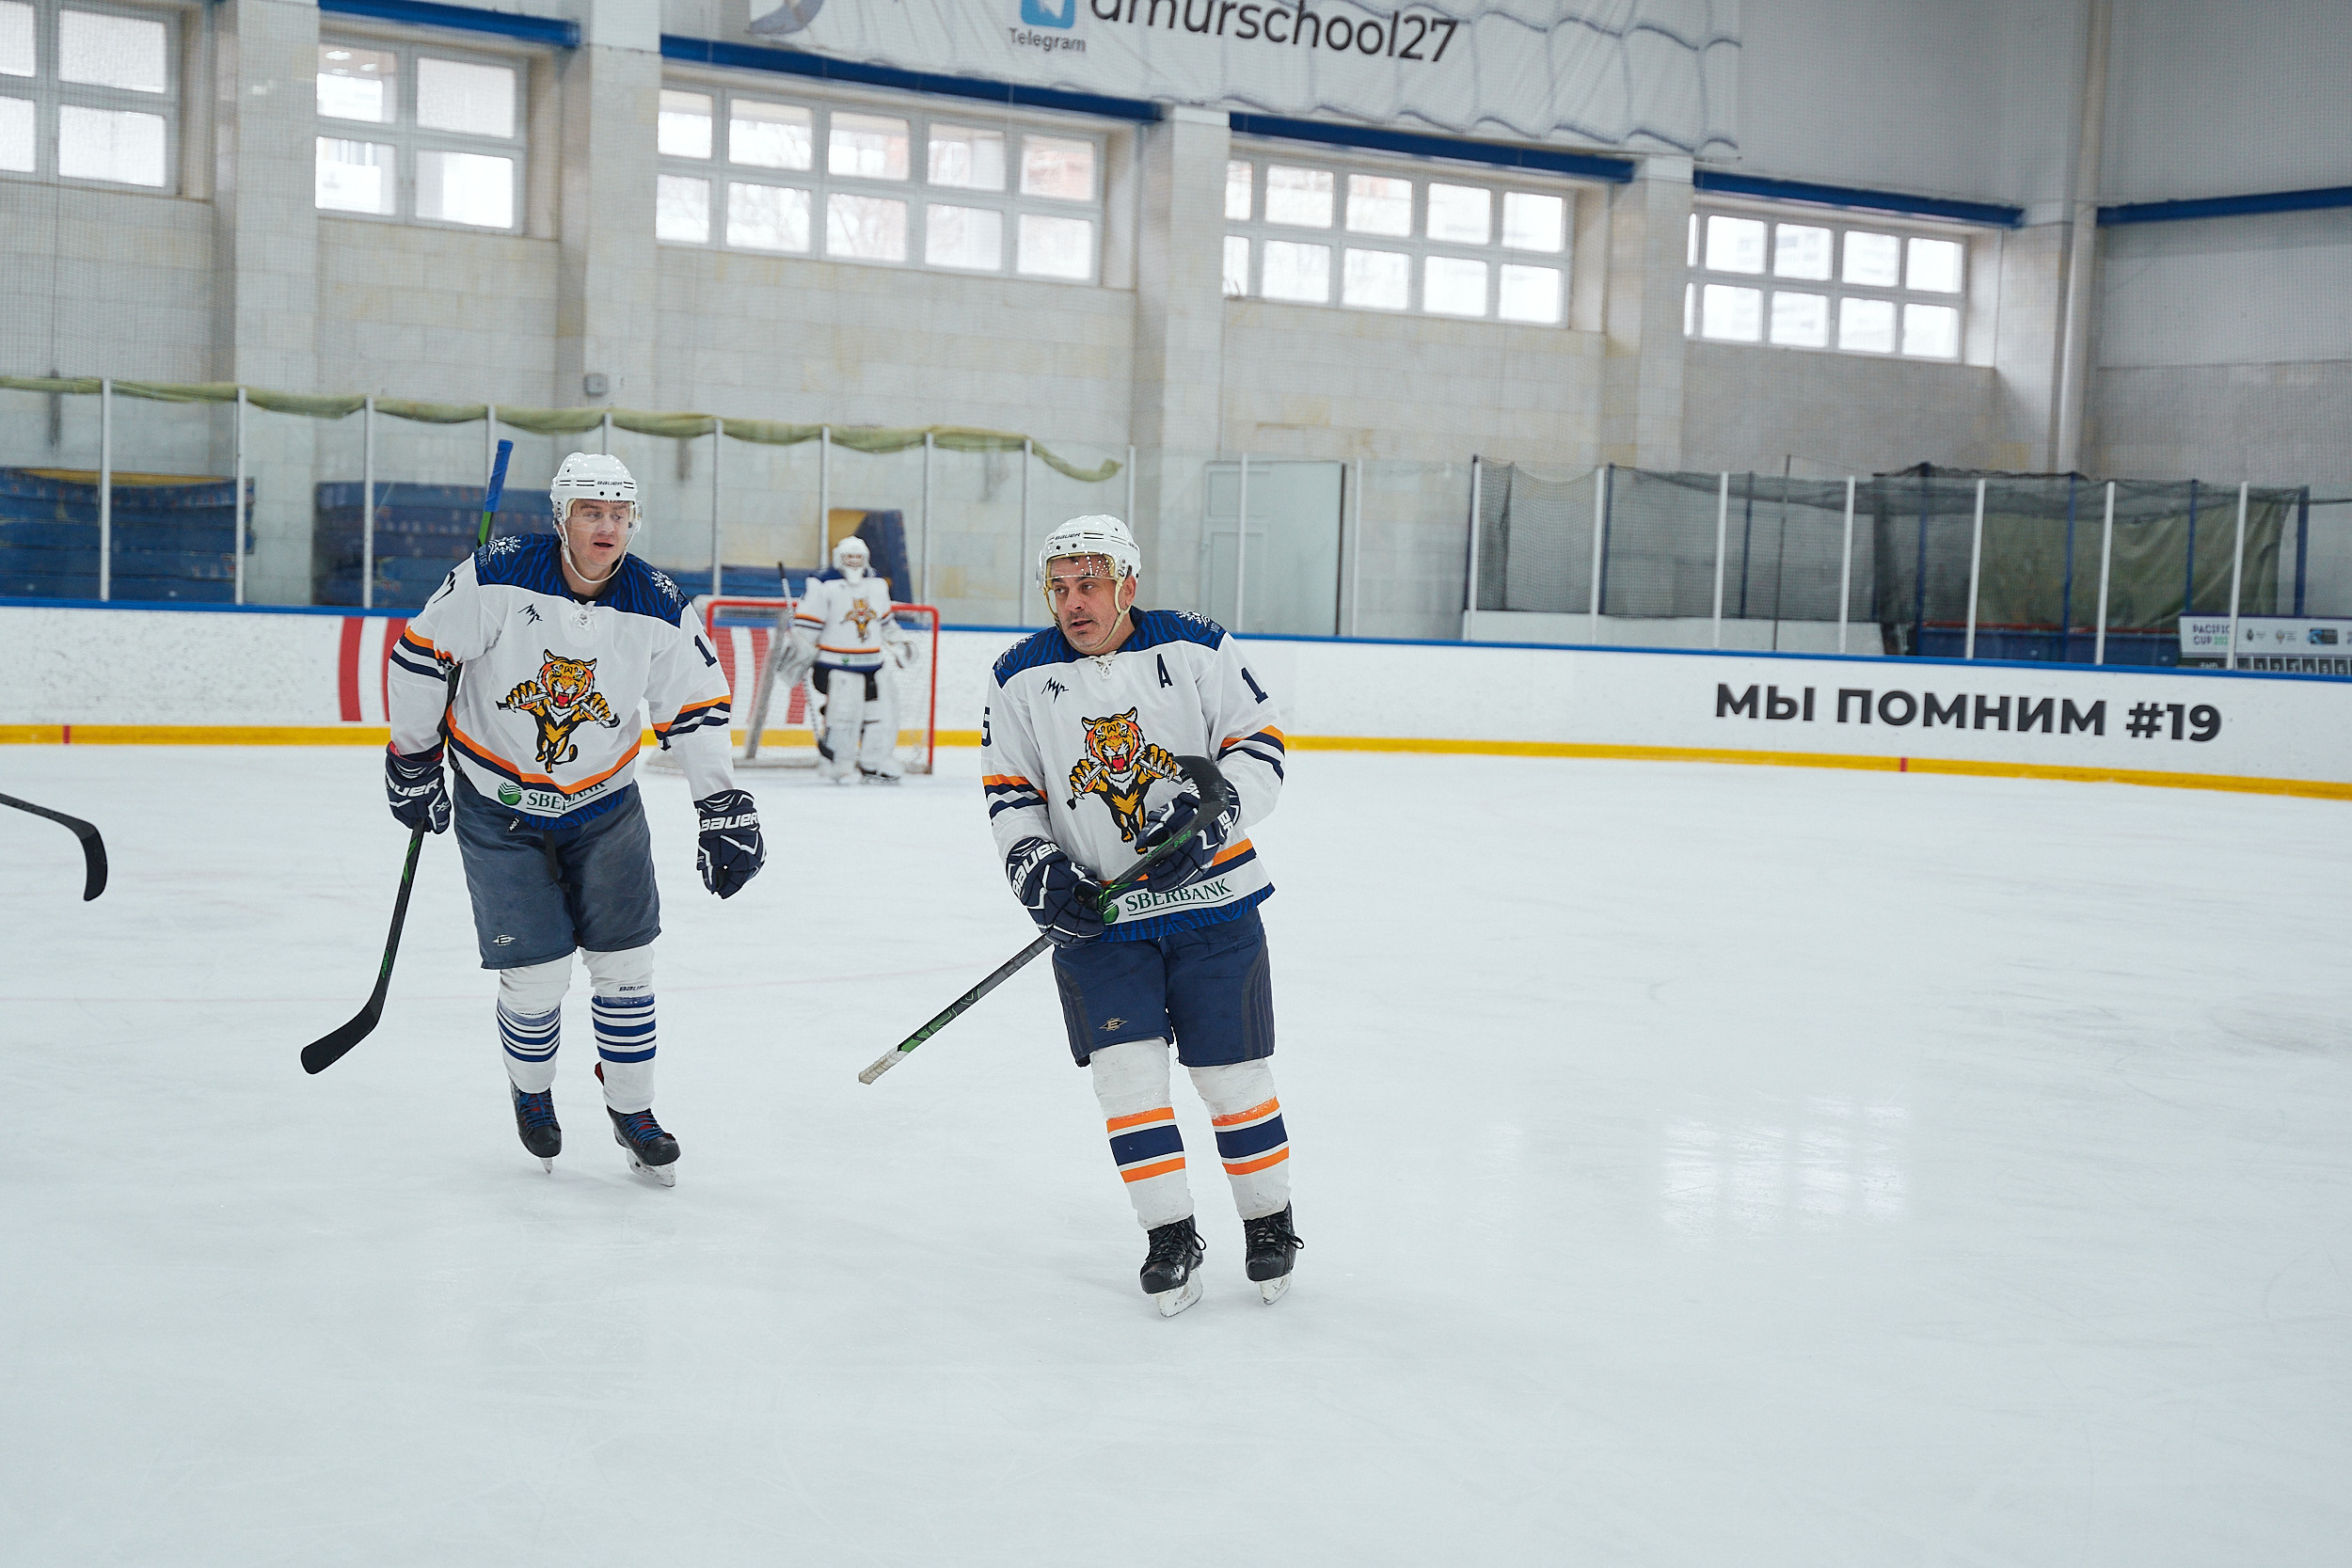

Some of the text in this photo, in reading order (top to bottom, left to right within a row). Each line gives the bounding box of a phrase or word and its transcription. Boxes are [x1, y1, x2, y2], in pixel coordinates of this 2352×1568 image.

[1009, 27, 1087, 52] Telegram
[2193, 635, 2212, 645] CUP
[1156, 653, 1173, 689] A
[1241, 667, 1269, 705] 1
[1715, 683, 2222, 743] МЫ ПОМНИМ #19
[700, 812, 758, 832] BAUER
[1124, 879, 1232, 912] SBERBANK
